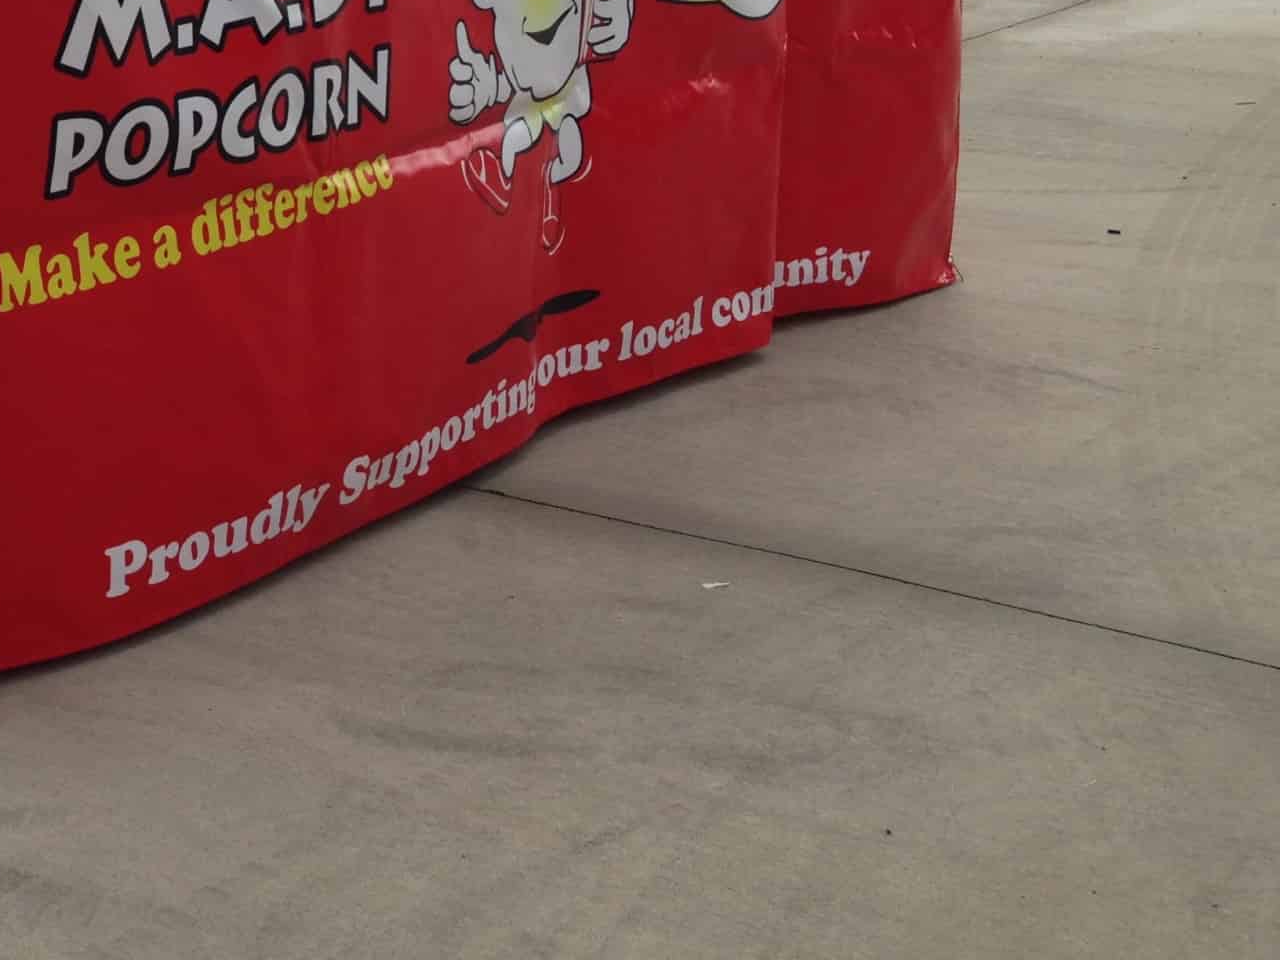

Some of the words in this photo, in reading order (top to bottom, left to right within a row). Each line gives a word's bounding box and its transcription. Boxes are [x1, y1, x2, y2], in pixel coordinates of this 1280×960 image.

[43, 43, 392, 200] POPCORN
[152, 224, 182, 271] a
[191, 153, 395, 257] difference
[104, 483, 330, 599] Proudly
[339, 365, 537, 506] Supporting
[537, 339, 608, 389] our
[618, 297, 704, 363] local
